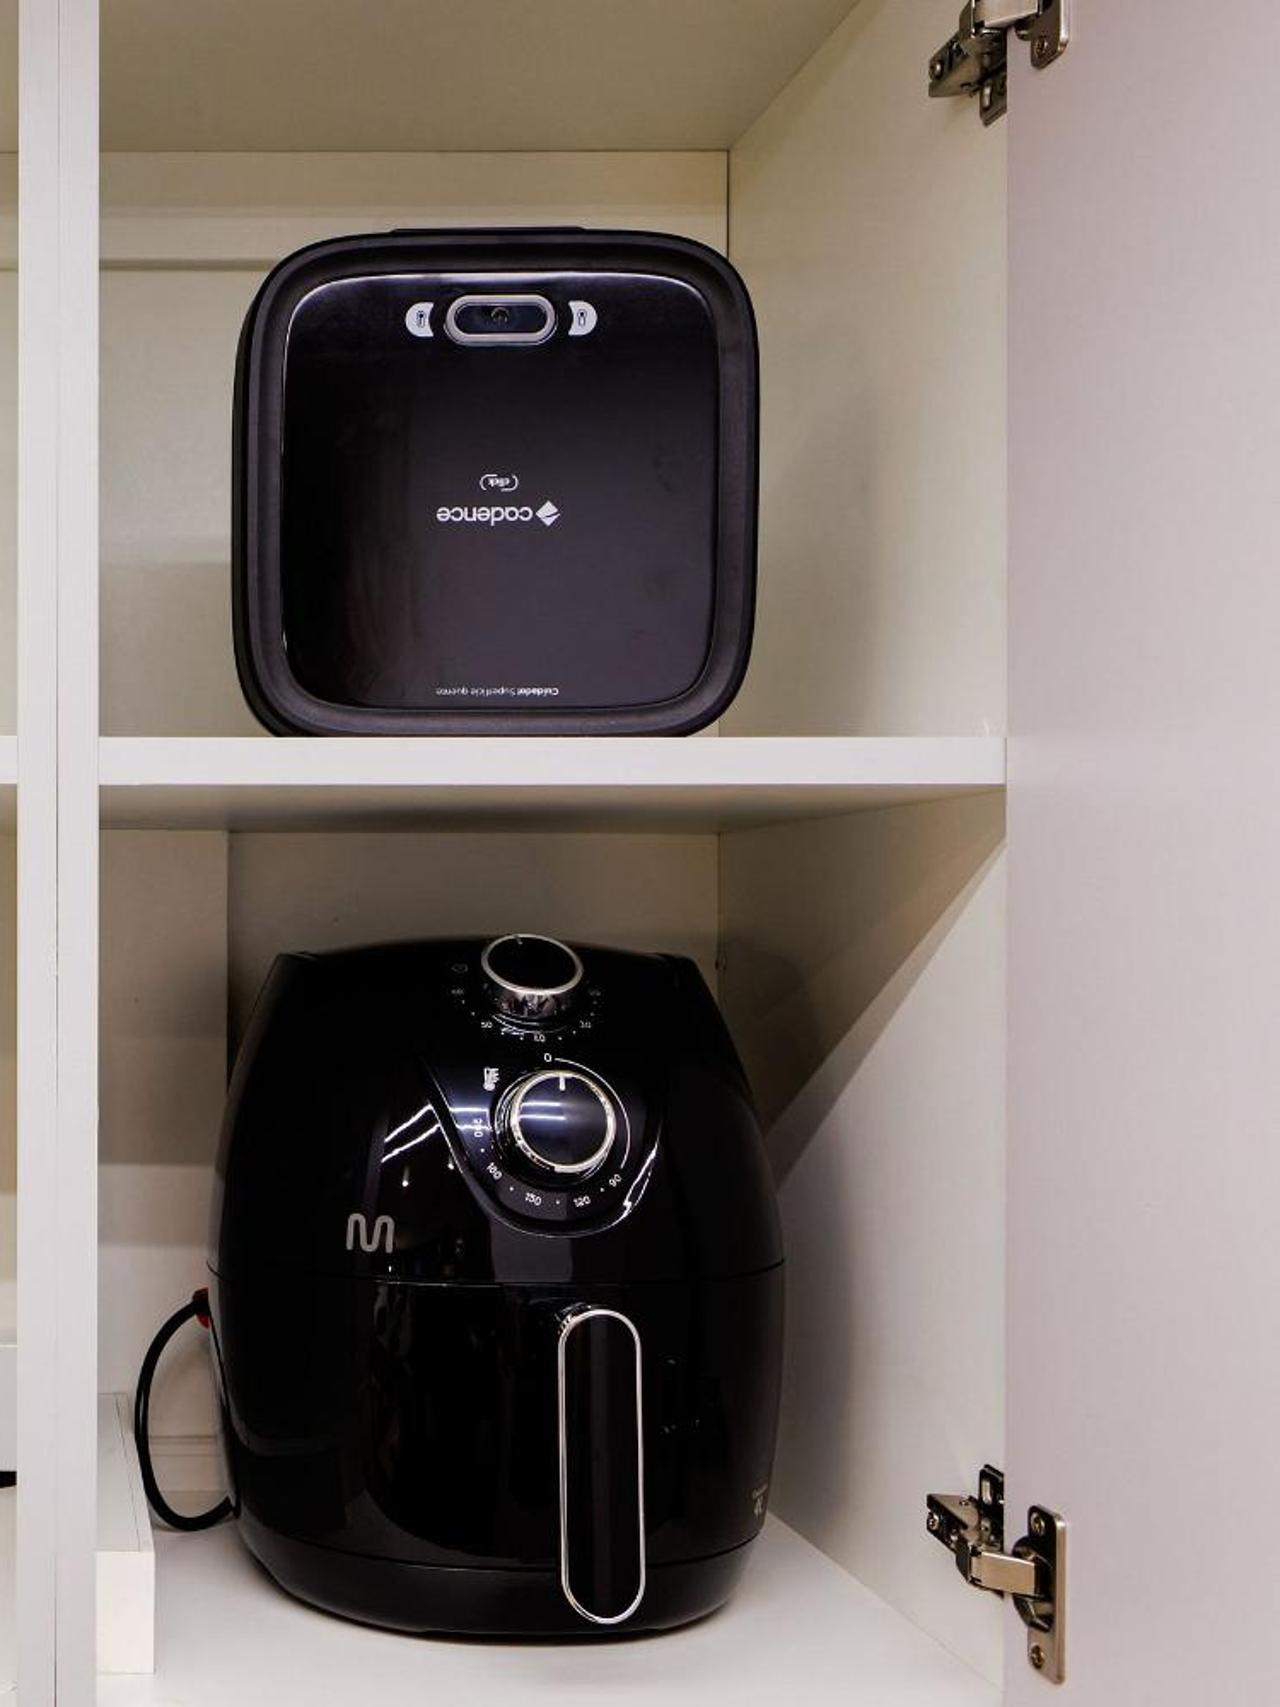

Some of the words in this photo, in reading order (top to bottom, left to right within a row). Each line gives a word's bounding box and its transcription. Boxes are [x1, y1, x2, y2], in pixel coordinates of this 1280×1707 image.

[436, 506, 533, 526] cadence
[543, 1052, 552, 1063] 0
[608, 1173, 622, 1187] 90
